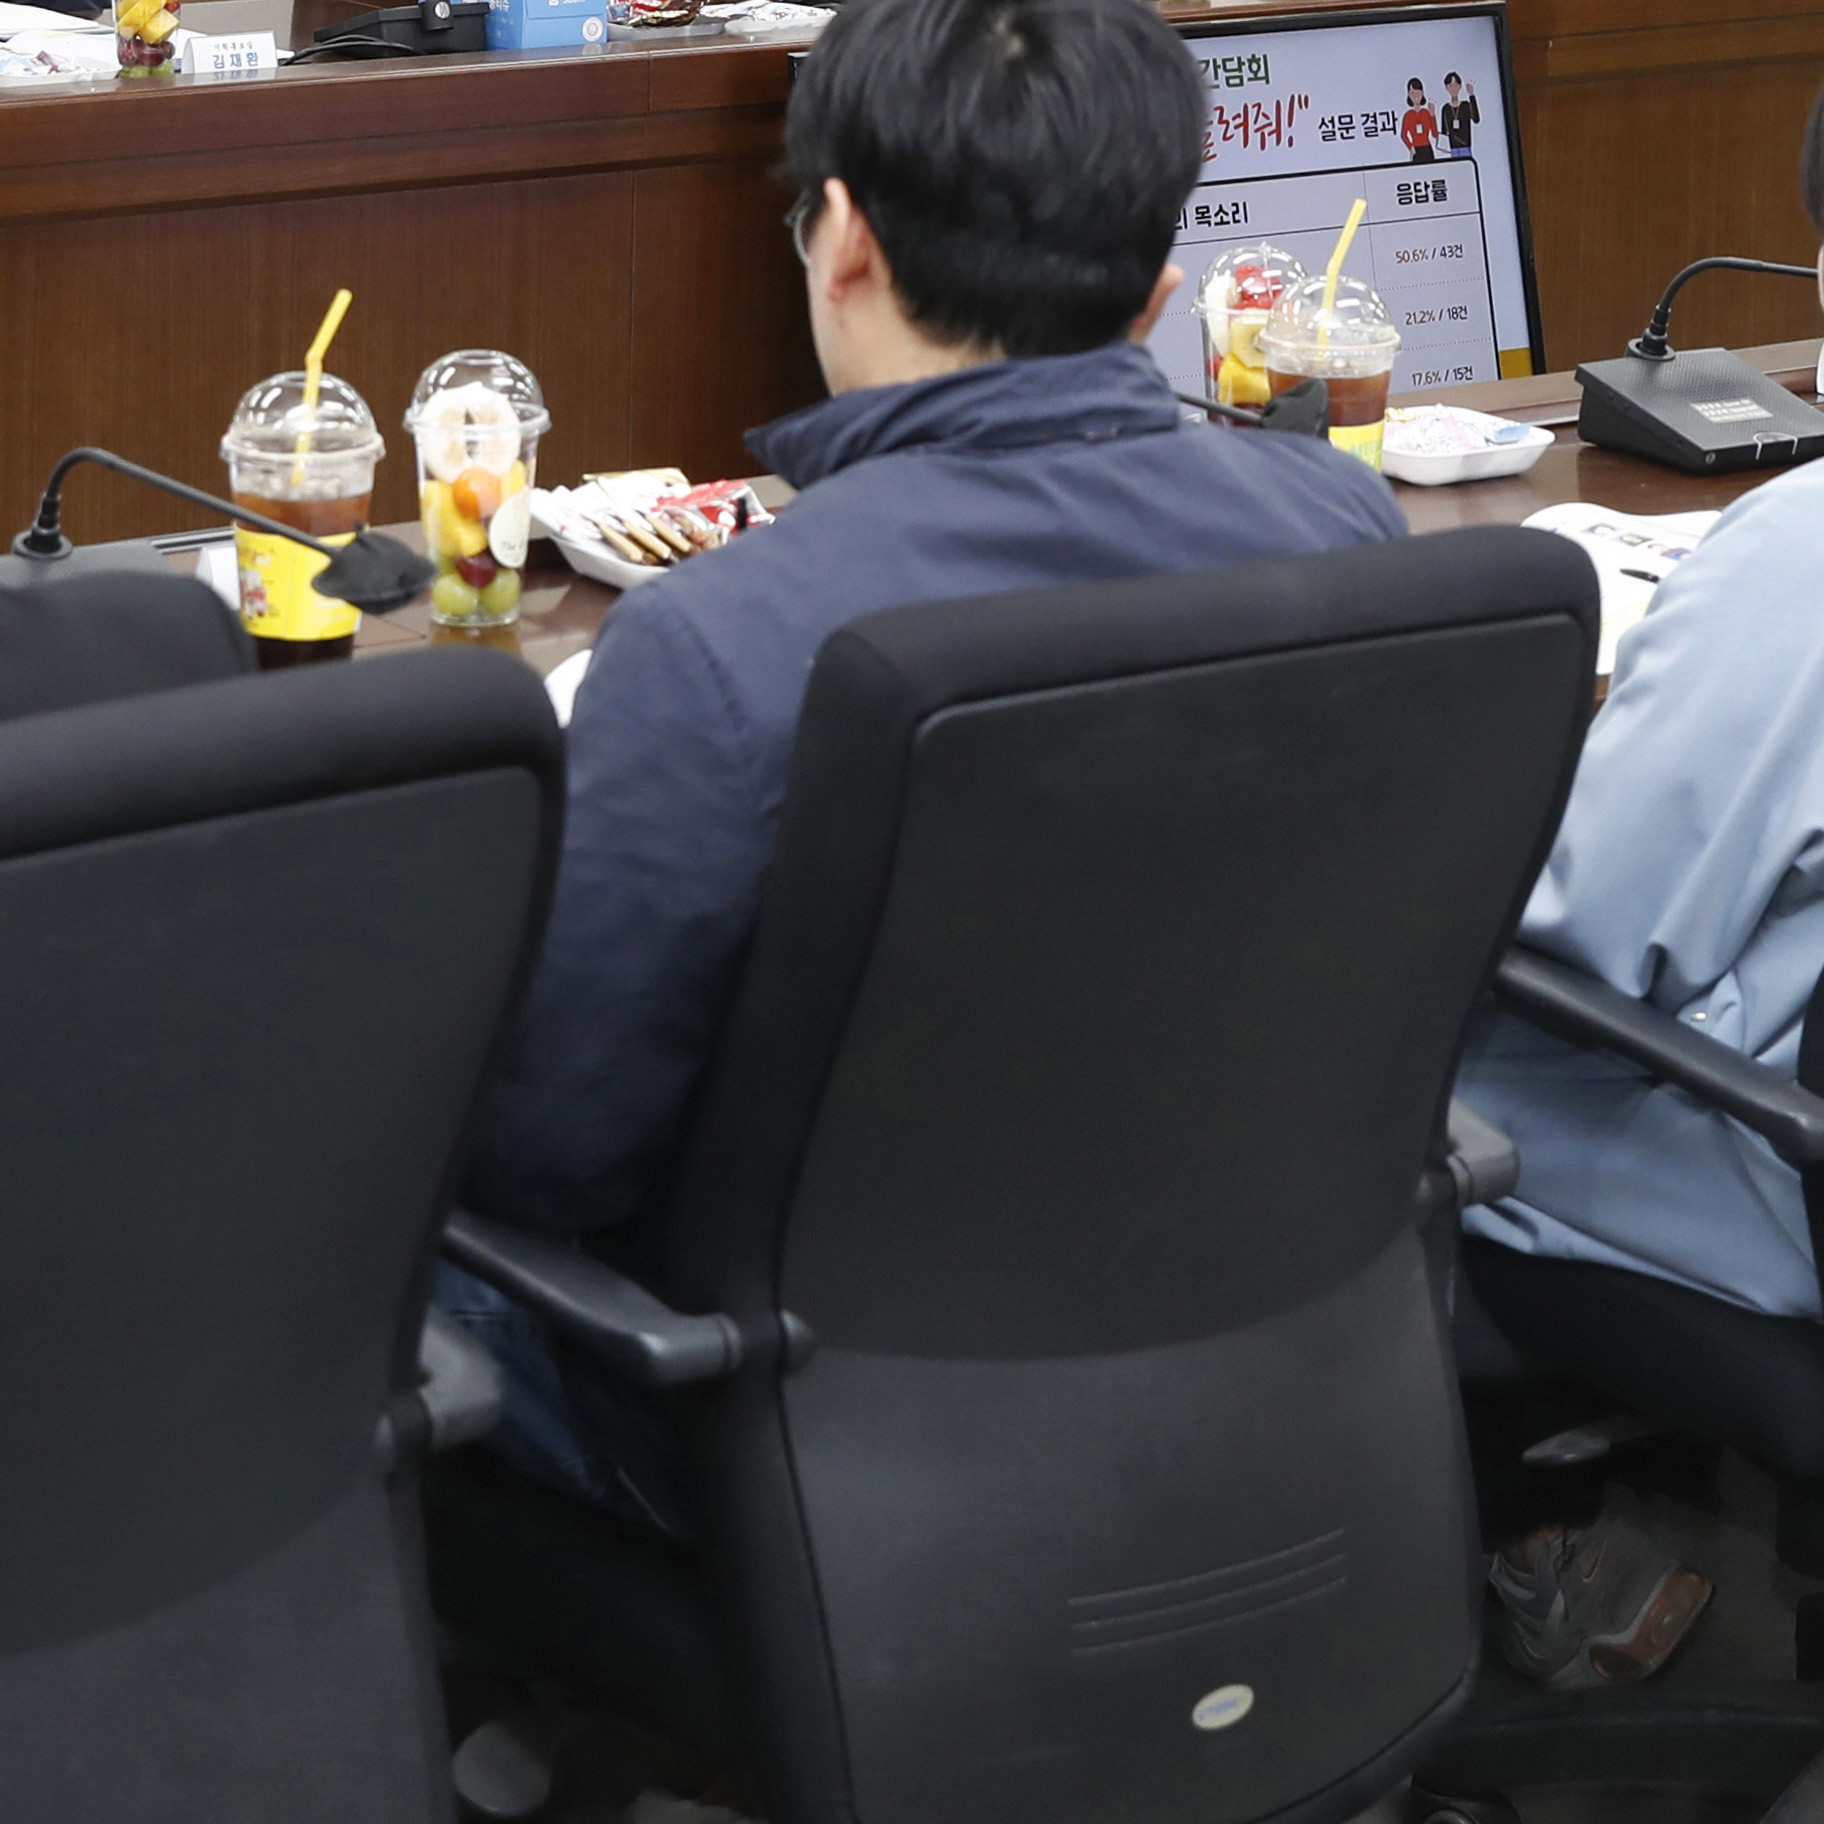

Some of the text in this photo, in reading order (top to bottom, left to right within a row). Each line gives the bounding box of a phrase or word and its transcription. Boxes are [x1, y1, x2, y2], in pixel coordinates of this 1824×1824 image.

[1200, 52, 1271, 89] 간담회
[1318, 113, 1356, 143] 설문
[1360, 110, 1399, 138] 결과
[1194, 200, 1250, 228] 목소리
[1395, 178, 1449, 207] 응답률
[1395, 246, 1429, 265] 50.6%
[1439, 243, 1464, 259] 43건
[1446, 305, 1469, 321] 18건
